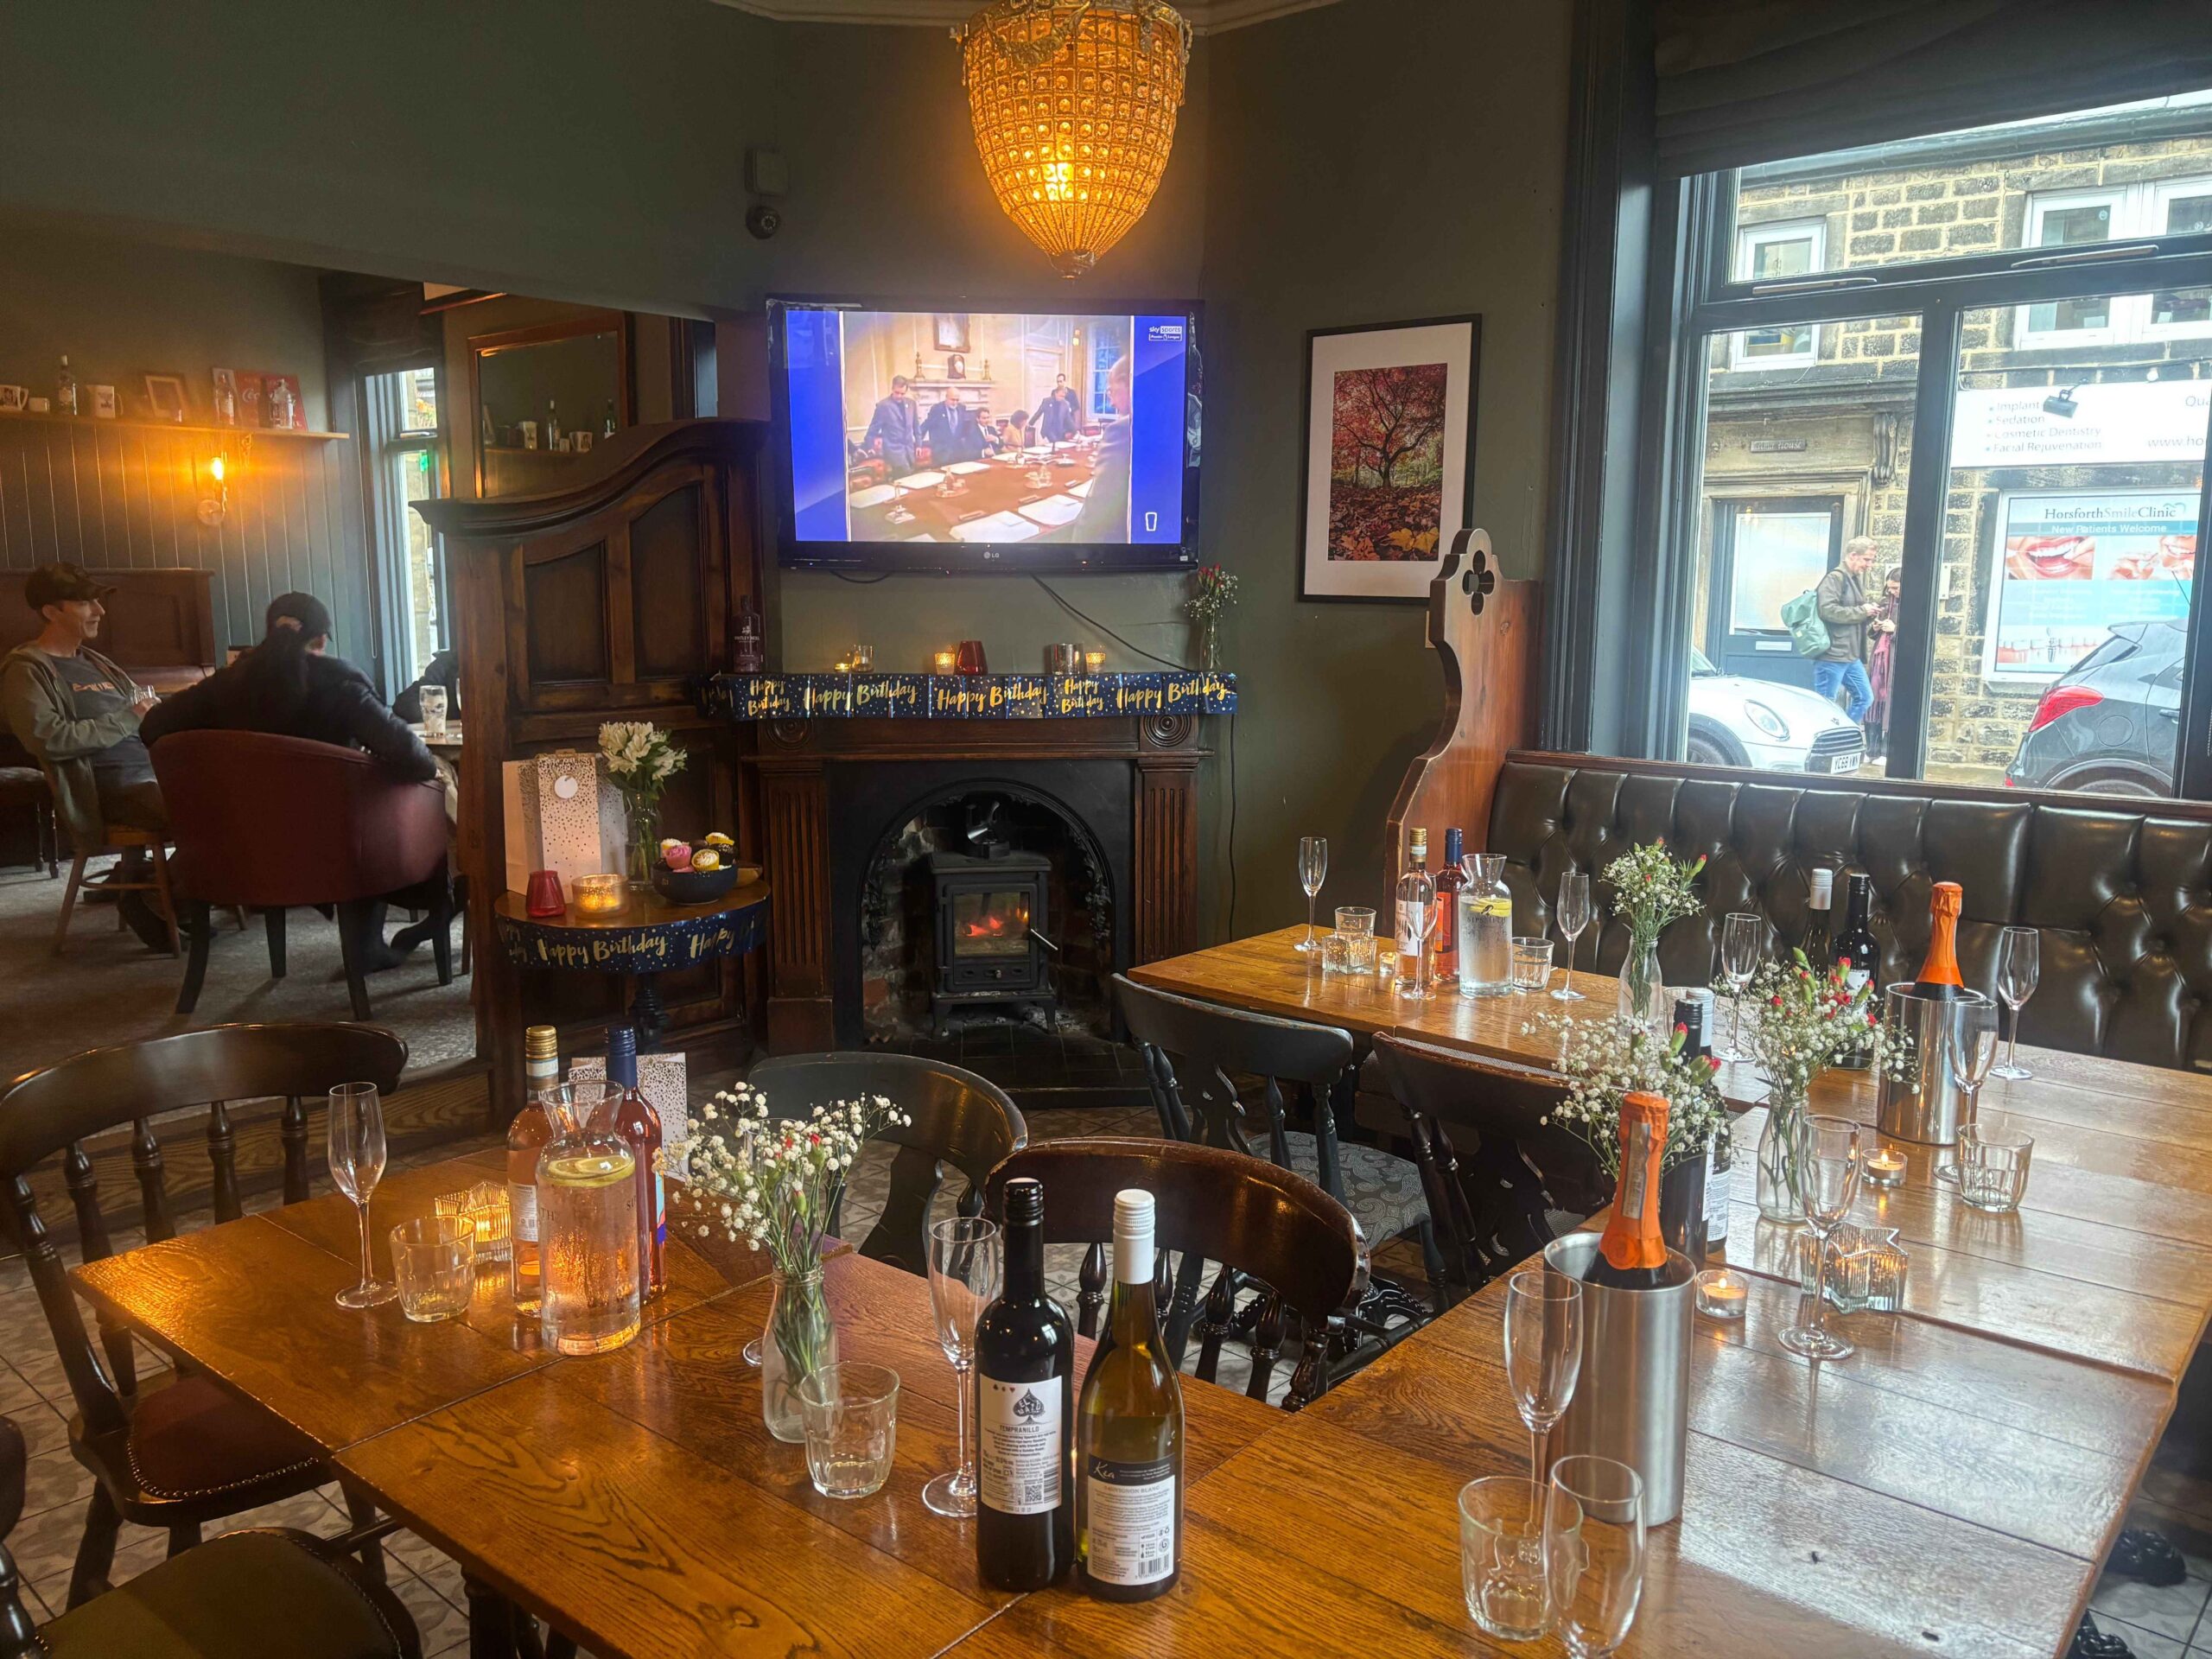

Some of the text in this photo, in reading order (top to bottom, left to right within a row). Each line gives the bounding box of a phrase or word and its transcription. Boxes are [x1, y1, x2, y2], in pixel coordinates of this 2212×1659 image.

[1995, 414, 2045, 425] Sedation
[2049, 427, 2102, 438] Dentistry
[2051, 524, 2167, 534] New Patients Welcome
[750, 678, 785, 696] Happy
[803, 679, 918, 711] Happy Birthday
[1064, 678, 1100, 695] Happy
[1116, 678, 1227, 709] Happy Birthday
[937, 681, 1049, 712] Happy Birthday
[1061, 695, 1105, 713] Birthday
[537, 938, 589, 966] Happy
[593, 932, 669, 962] Birthday
[1000, 1425, 1039, 1433] TEMPRANILLO
